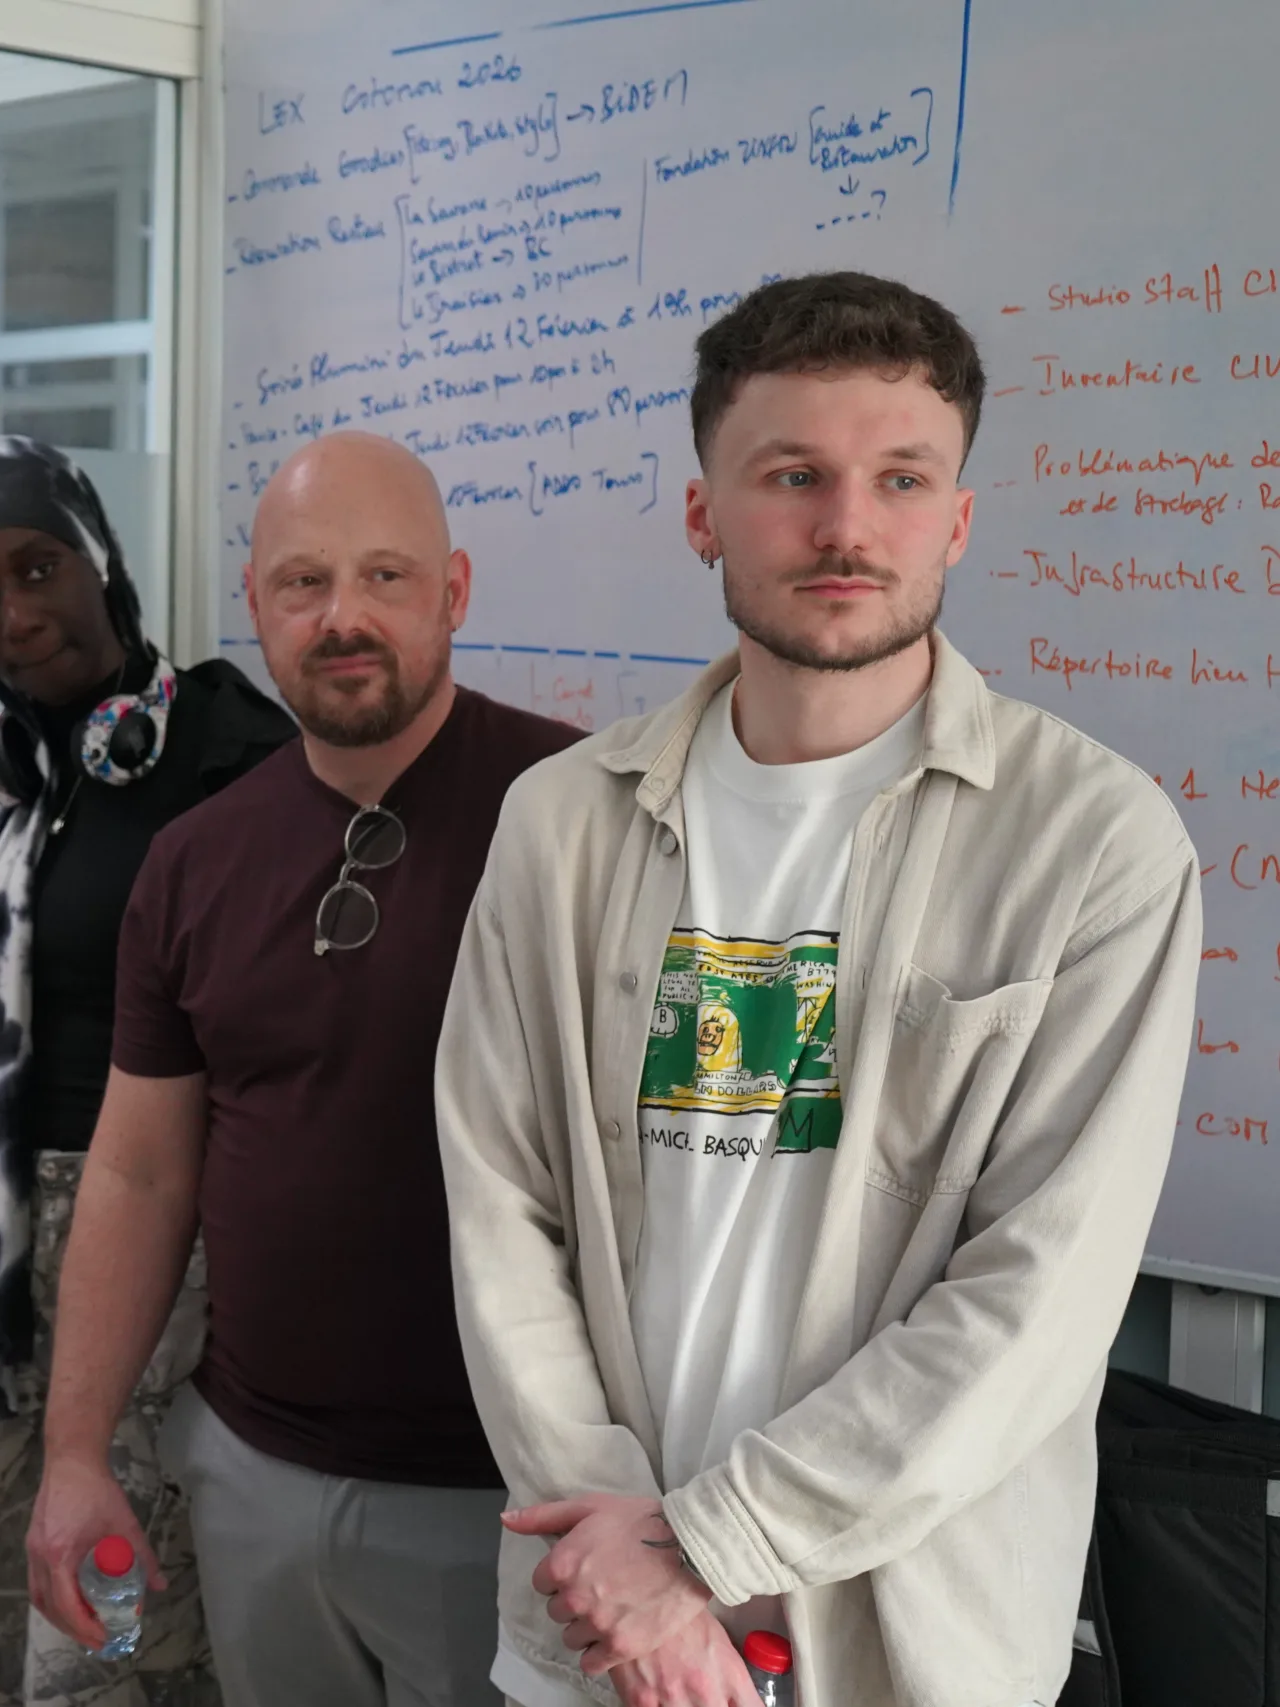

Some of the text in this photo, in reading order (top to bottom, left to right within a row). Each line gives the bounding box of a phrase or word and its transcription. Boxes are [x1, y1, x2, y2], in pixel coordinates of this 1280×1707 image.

[258, 90, 306, 135] LEX
[457, 54, 523, 89] 2026
[1048, 283, 1131, 311] Studio
[1144, 263, 1223, 313] Staff
[1032, 354, 1202, 397] Inventaire
[1023, 550, 1246, 597] Infrastructure
[1030, 637, 1174, 692] Répertoire
[659, 1008, 668, 1024] B
